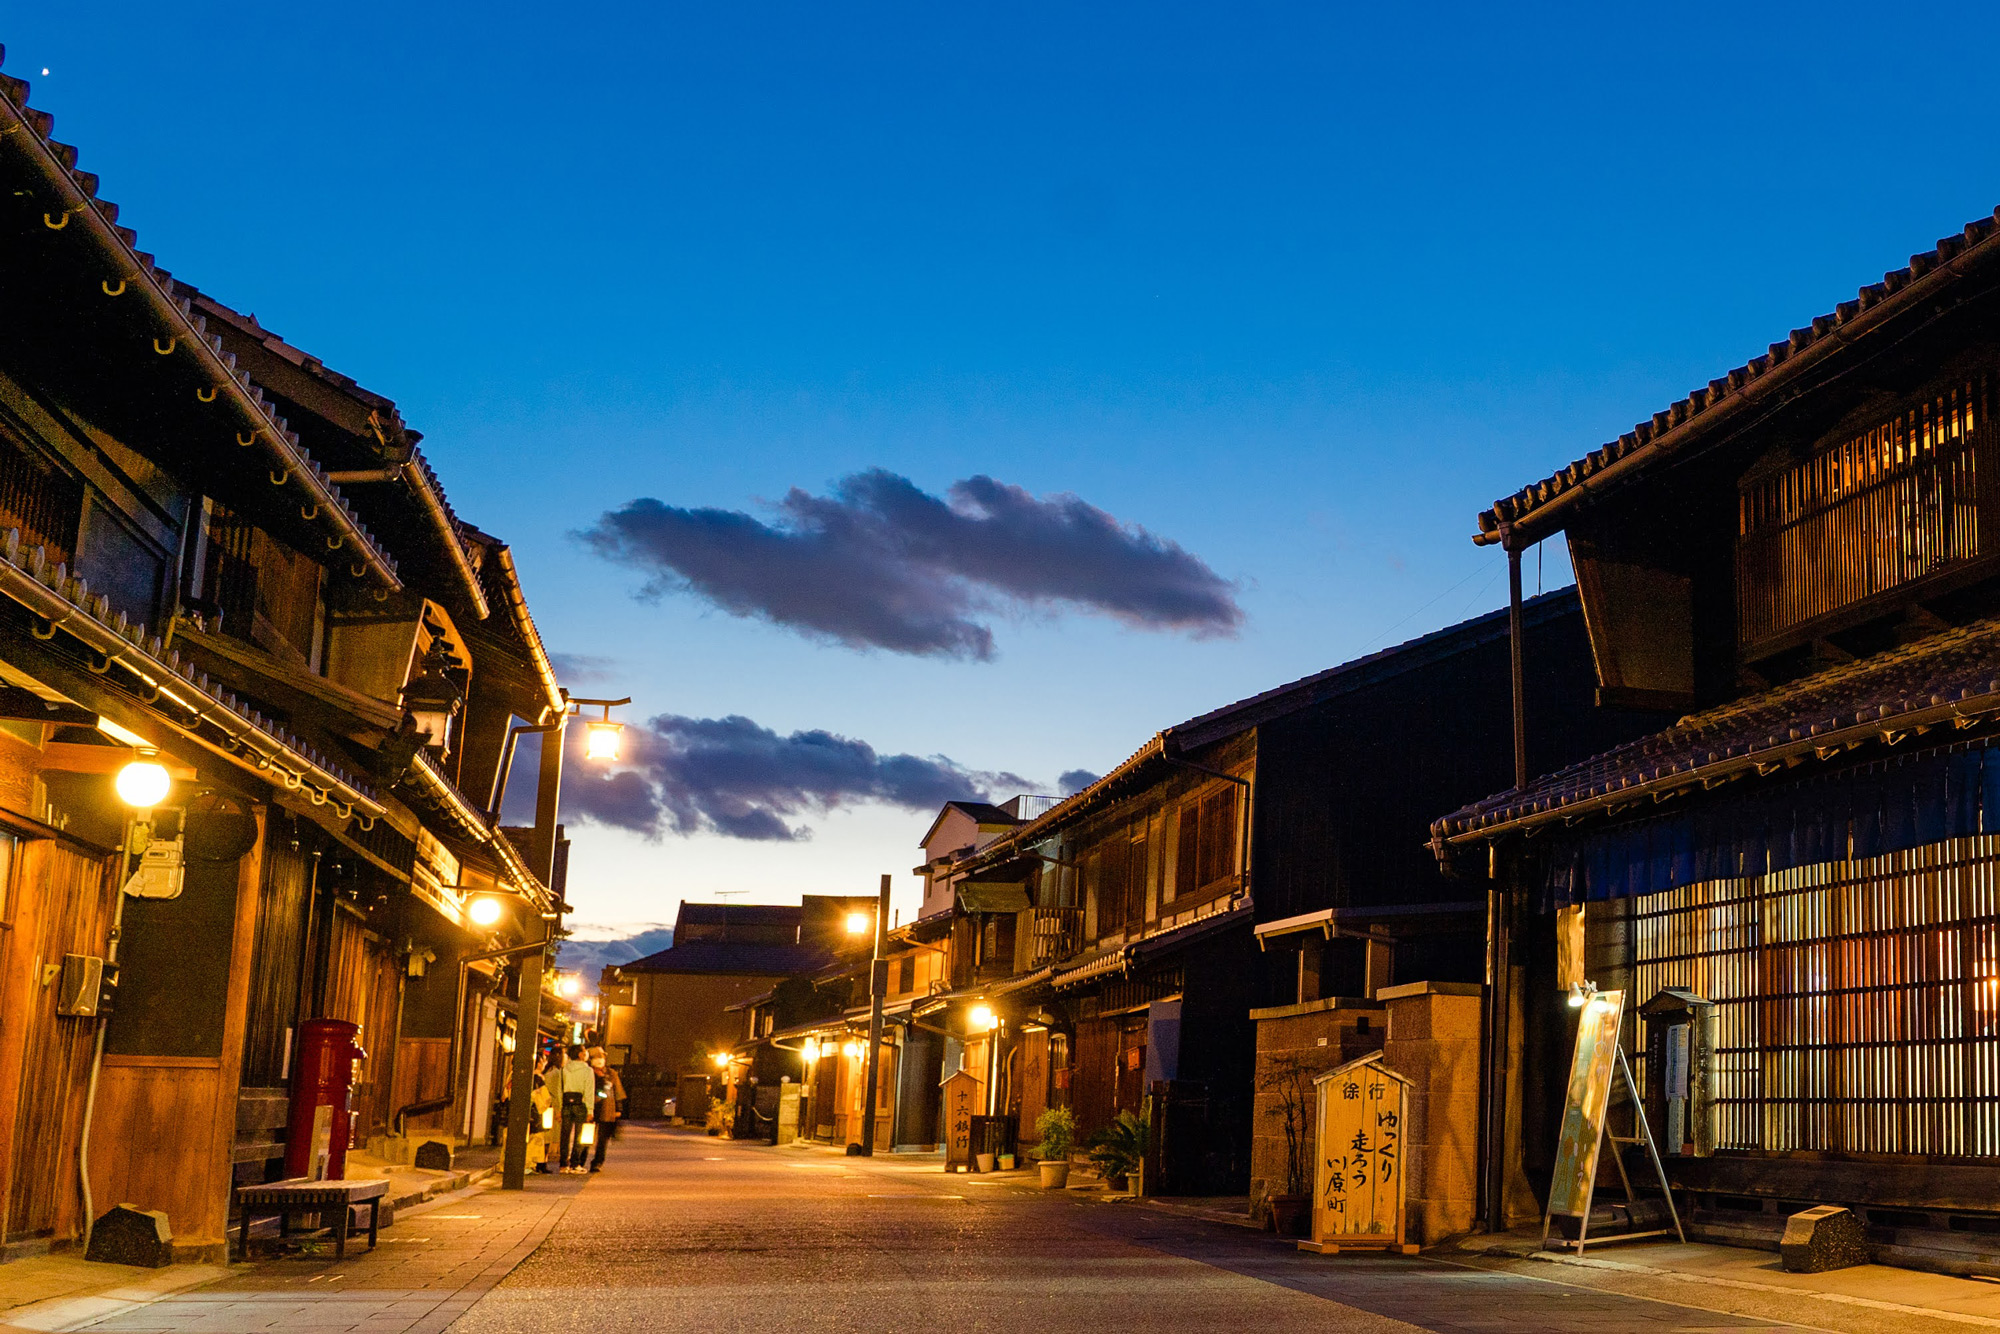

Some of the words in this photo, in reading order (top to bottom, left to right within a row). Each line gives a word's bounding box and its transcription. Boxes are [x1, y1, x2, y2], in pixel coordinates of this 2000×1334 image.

[955, 1091, 969, 1149] 十六銀行
[1343, 1083, 1385, 1100] 徐行
[1351, 1129, 1374, 1188] 走ろう
[1378, 1111, 1398, 1183] ゆっくり
[1325, 1156, 1347, 1213] 川原町
